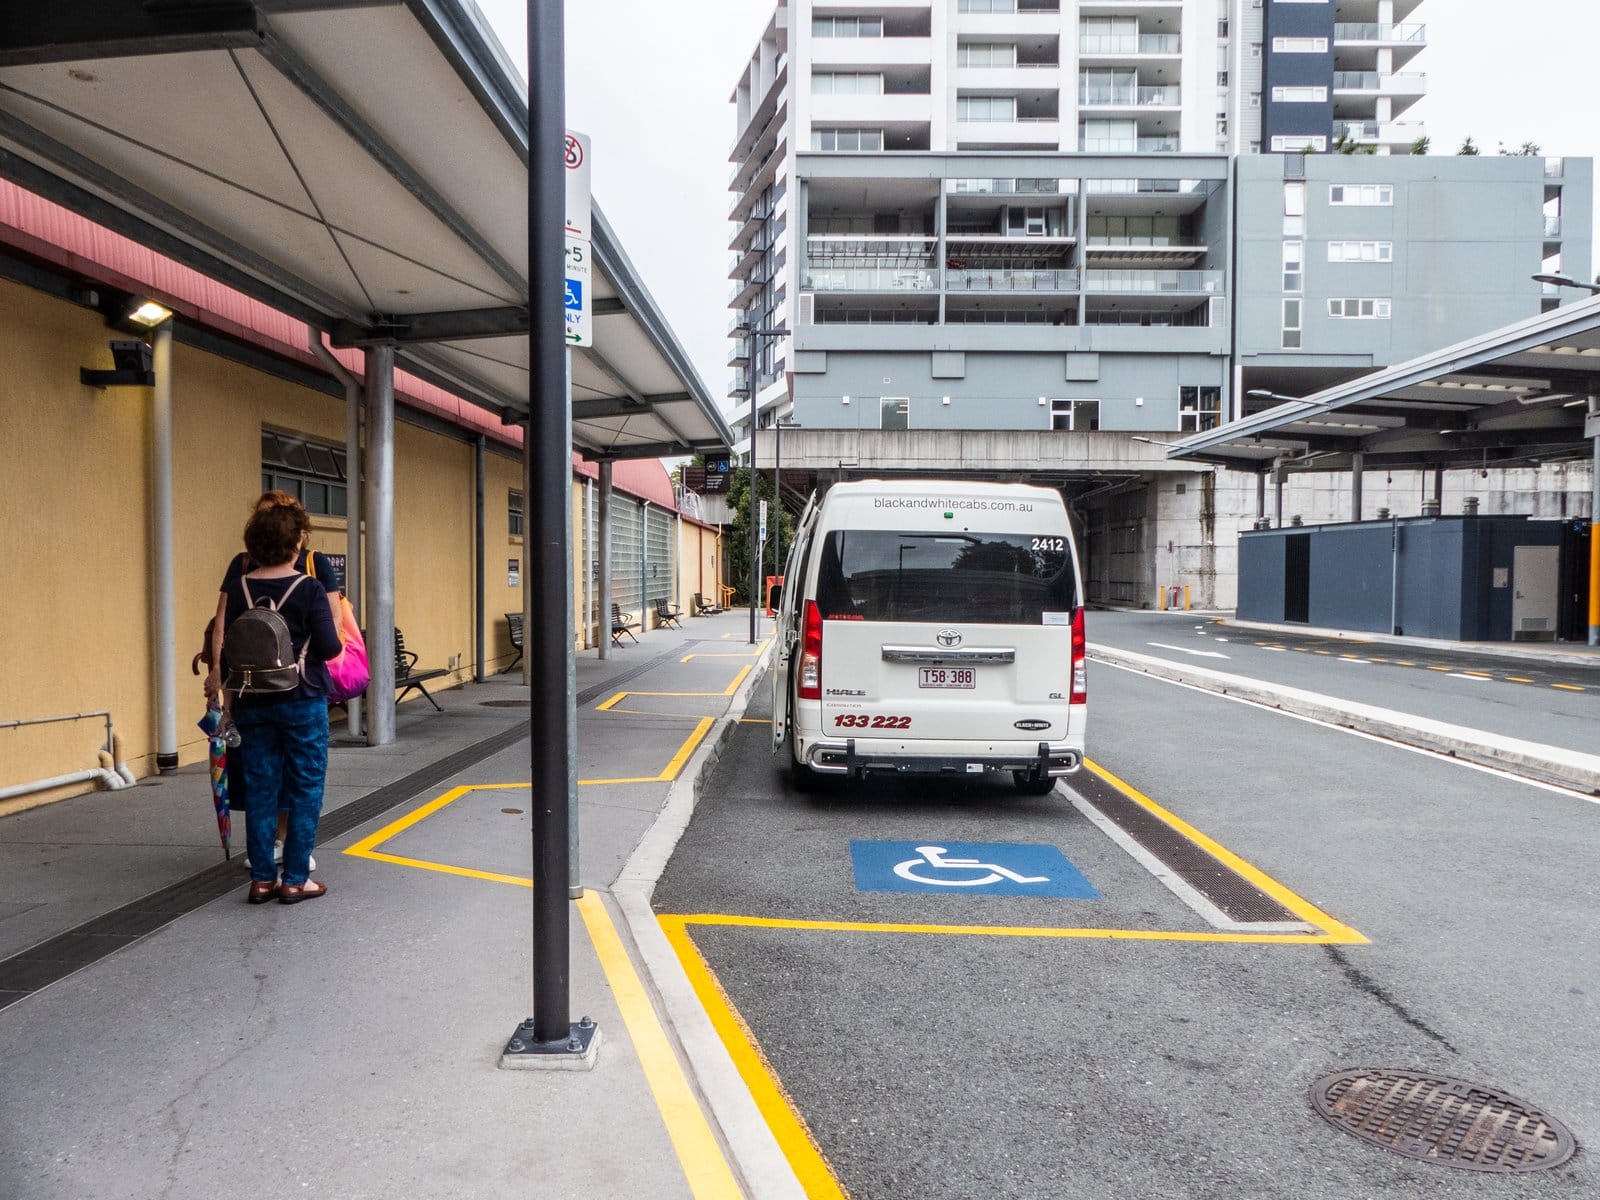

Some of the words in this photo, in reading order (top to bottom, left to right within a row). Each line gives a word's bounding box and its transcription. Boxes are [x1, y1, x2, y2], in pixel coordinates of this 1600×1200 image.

[573, 247, 582, 262] 5
[565, 313, 581, 324] NLY
[874, 497, 1033, 512] blackandwhitecabs.com.au
[1031, 537, 1065, 551] 2412
[1049, 692, 1065, 700] GL
[834, 714, 870, 728] 133
[870, 715, 912, 729] 222
